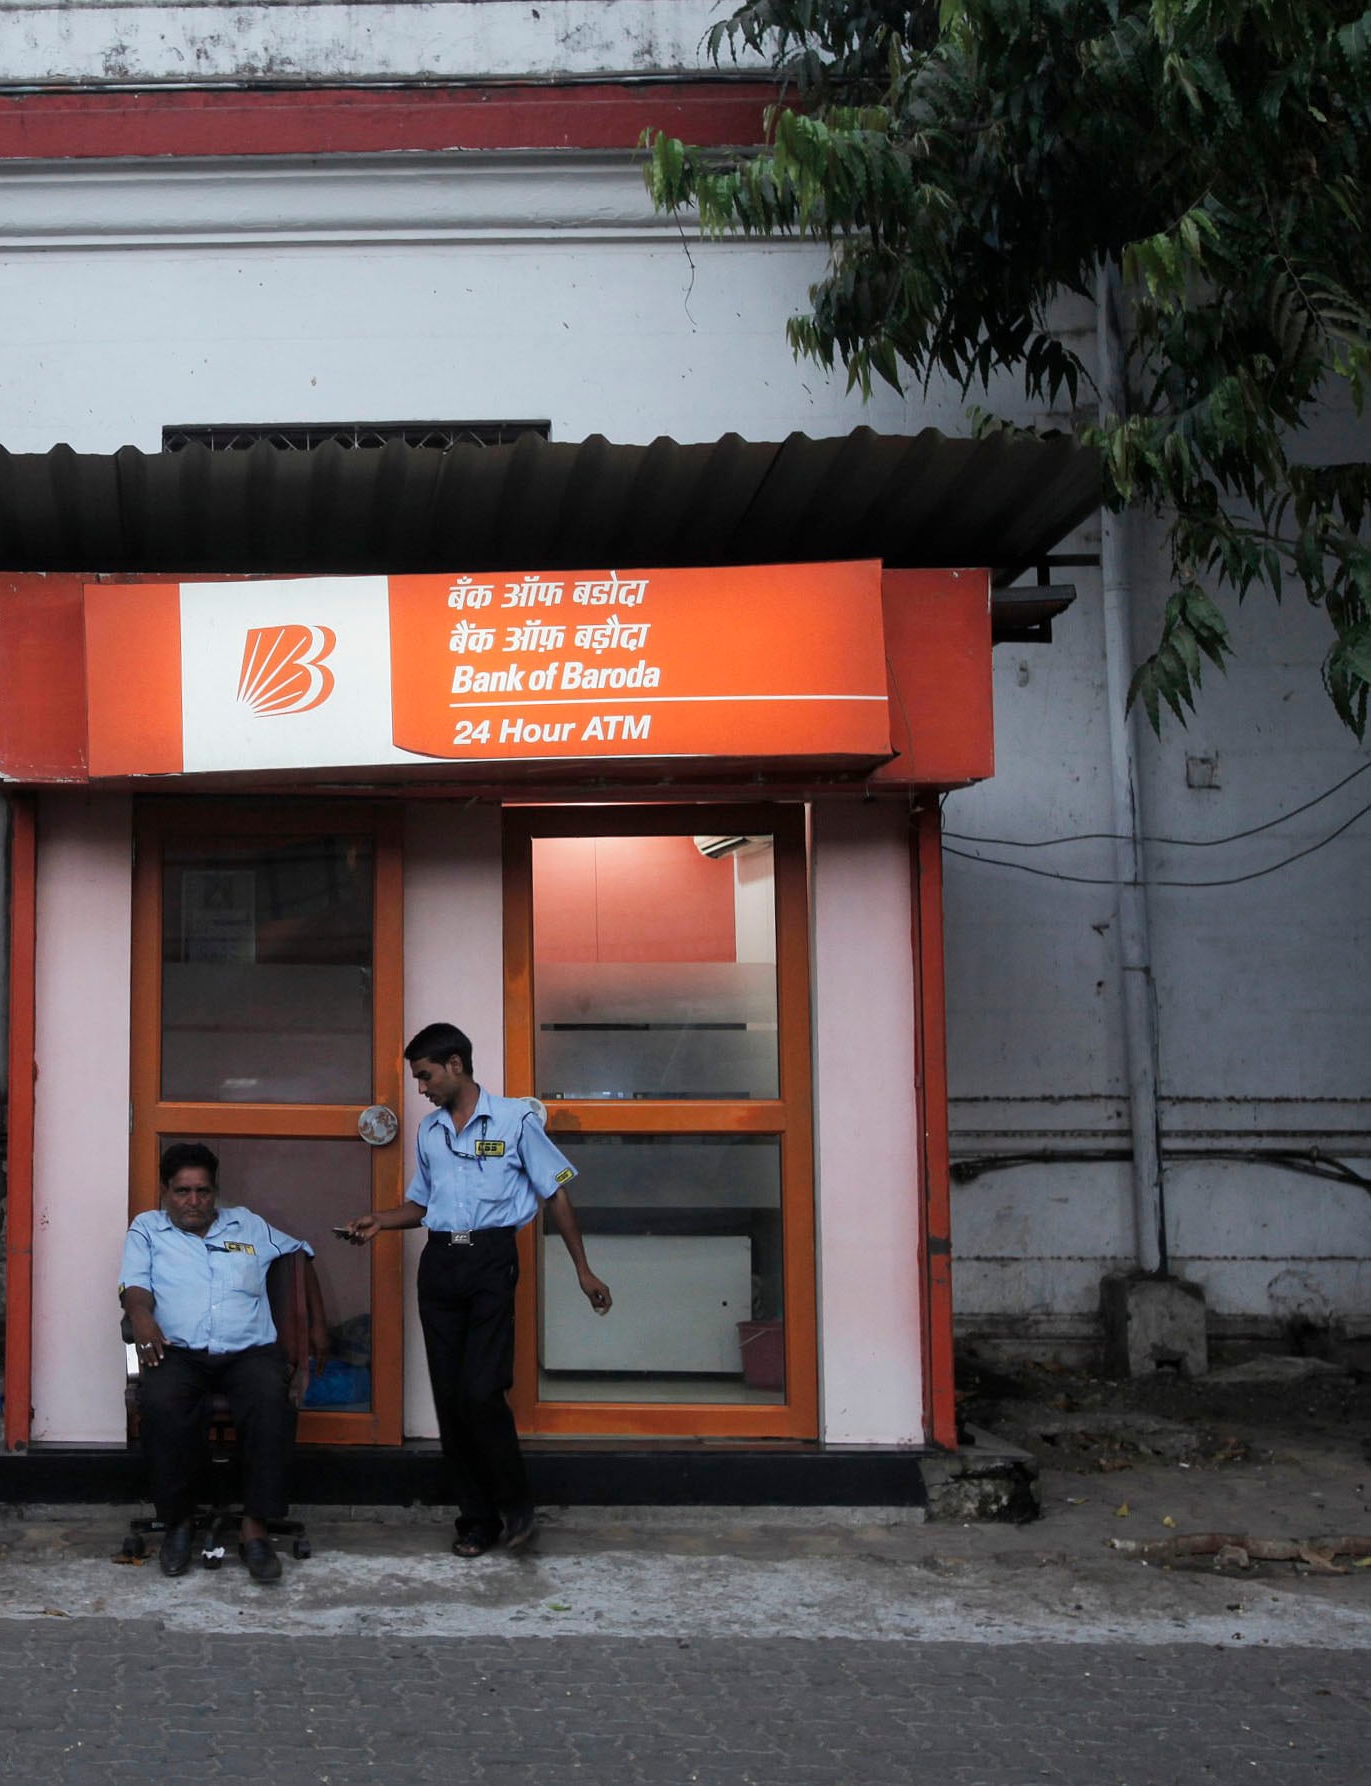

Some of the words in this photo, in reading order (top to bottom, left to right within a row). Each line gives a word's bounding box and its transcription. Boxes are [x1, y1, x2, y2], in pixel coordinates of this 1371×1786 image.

[501, 576, 565, 608] ऑफ
[573, 570, 650, 607] बडोदा
[449, 619, 497, 654] बैंक
[574, 614, 652, 655] बड़ौदा
[451, 664, 526, 694] Bank
[528, 661, 560, 690] of
[560, 660, 660, 690] Baroda
[453, 720, 492, 745] 24
[498, 718, 576, 744] Hour
[580, 715, 652, 742] ATM
